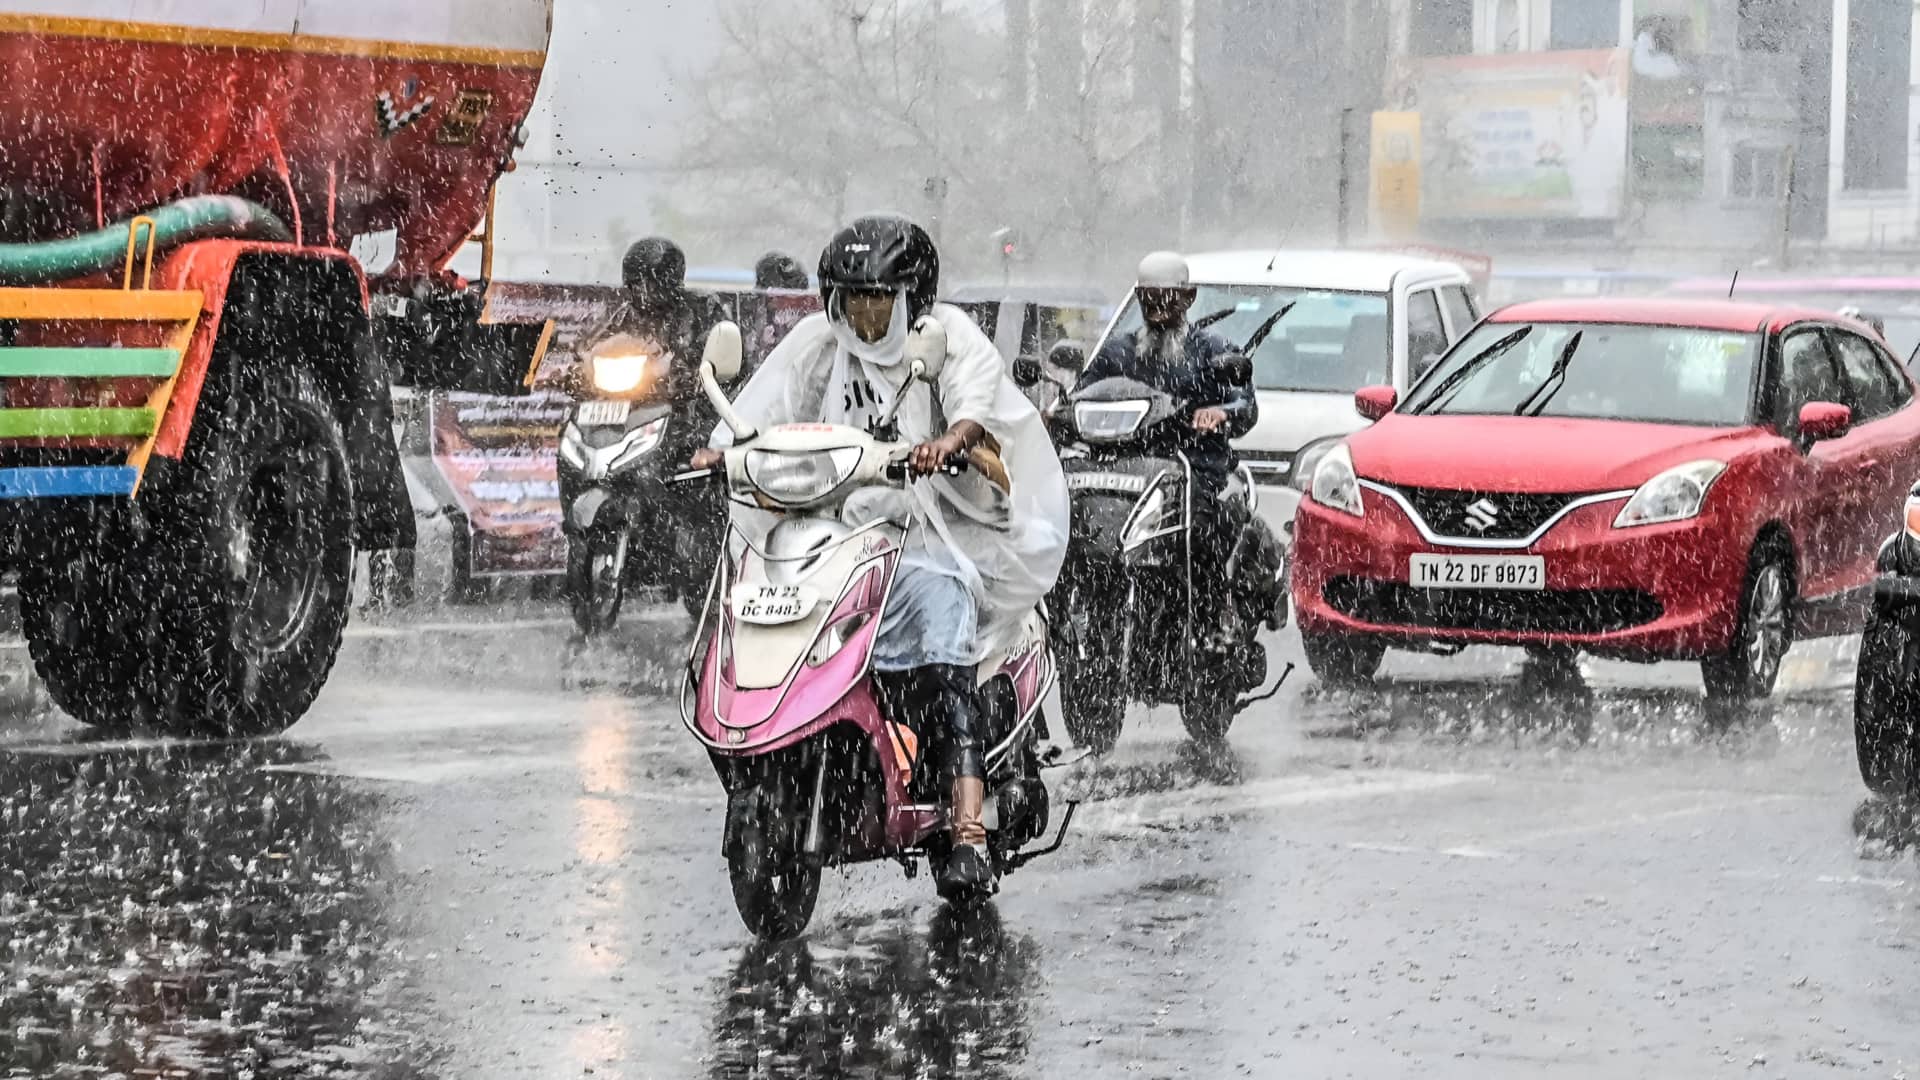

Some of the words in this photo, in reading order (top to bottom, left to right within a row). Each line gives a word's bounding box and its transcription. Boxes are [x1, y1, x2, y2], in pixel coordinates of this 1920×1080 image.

[1420, 562, 1439, 582] TN
[1445, 562, 1464, 582] 22
[1471, 564, 1490, 583] DF
[759, 585, 778, 598] TN
[782, 585, 800, 598] 22
[741, 604, 762, 617] DC
